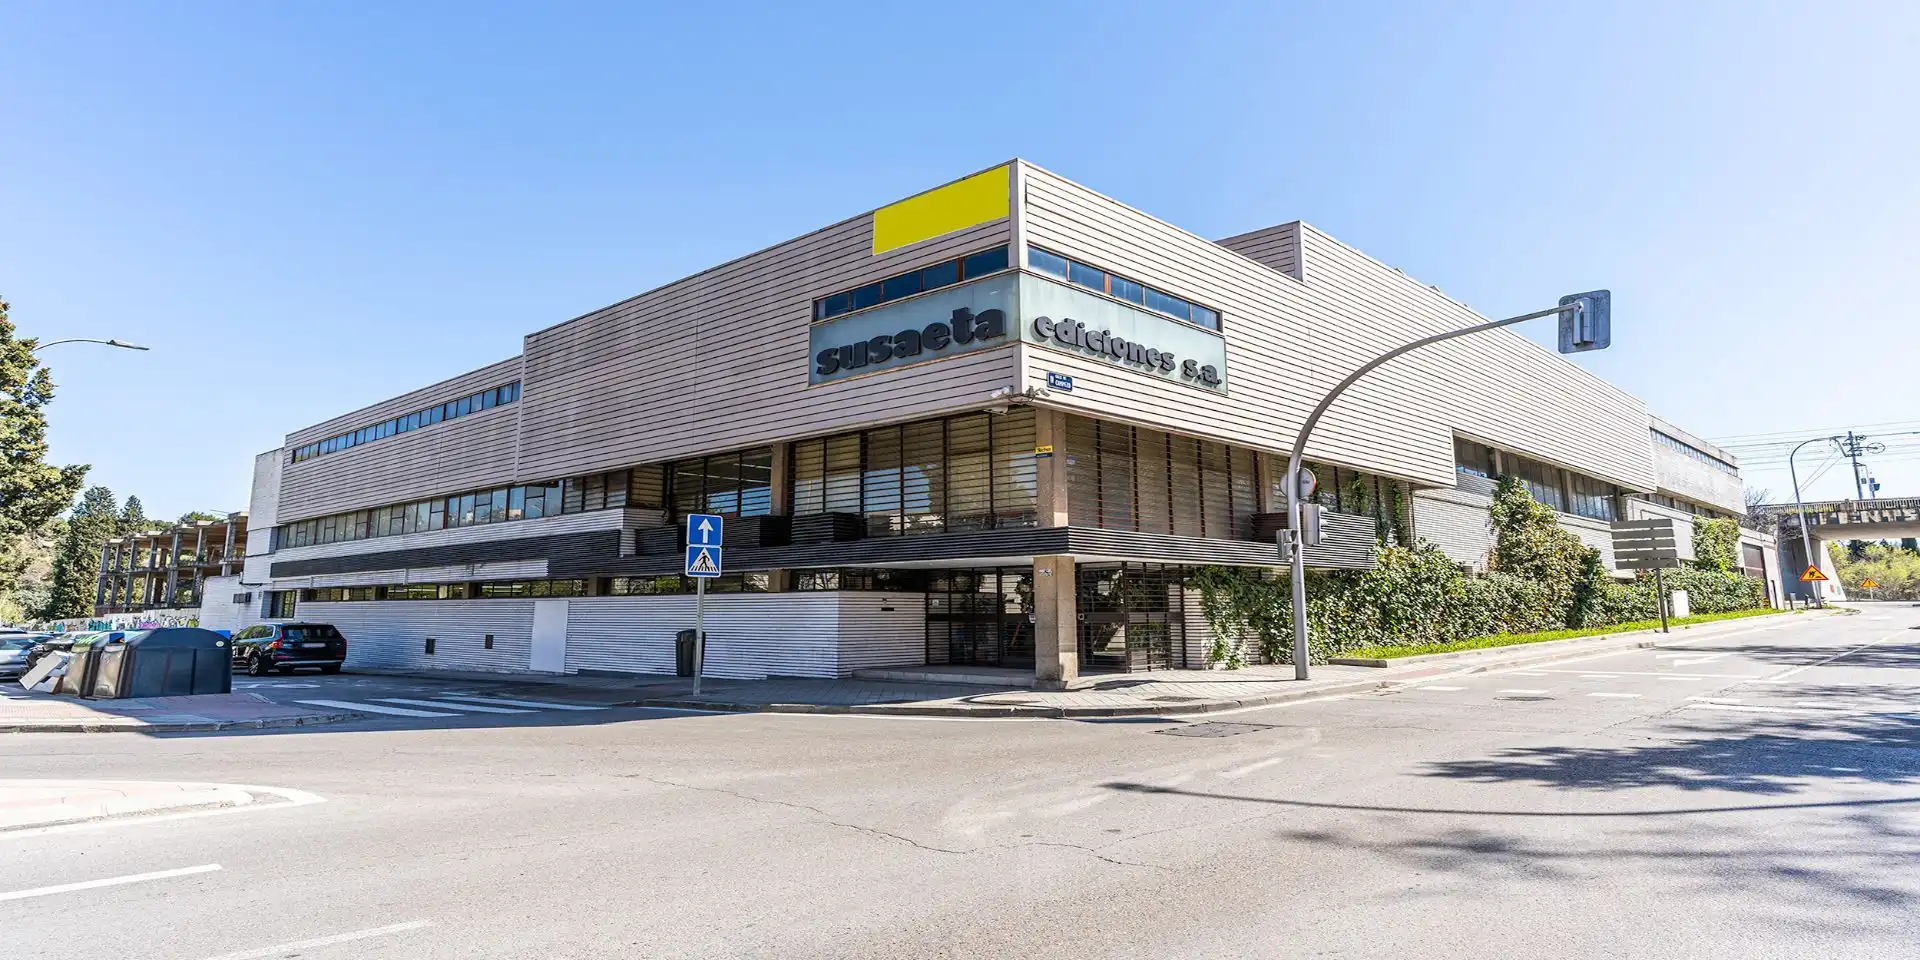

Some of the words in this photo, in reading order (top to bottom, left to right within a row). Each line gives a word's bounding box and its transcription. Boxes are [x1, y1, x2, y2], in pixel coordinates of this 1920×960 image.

[816, 307, 1006, 375] susaeta
[1031, 316, 1176, 373] ediciones
[1181, 359, 1222, 387] s.a.
